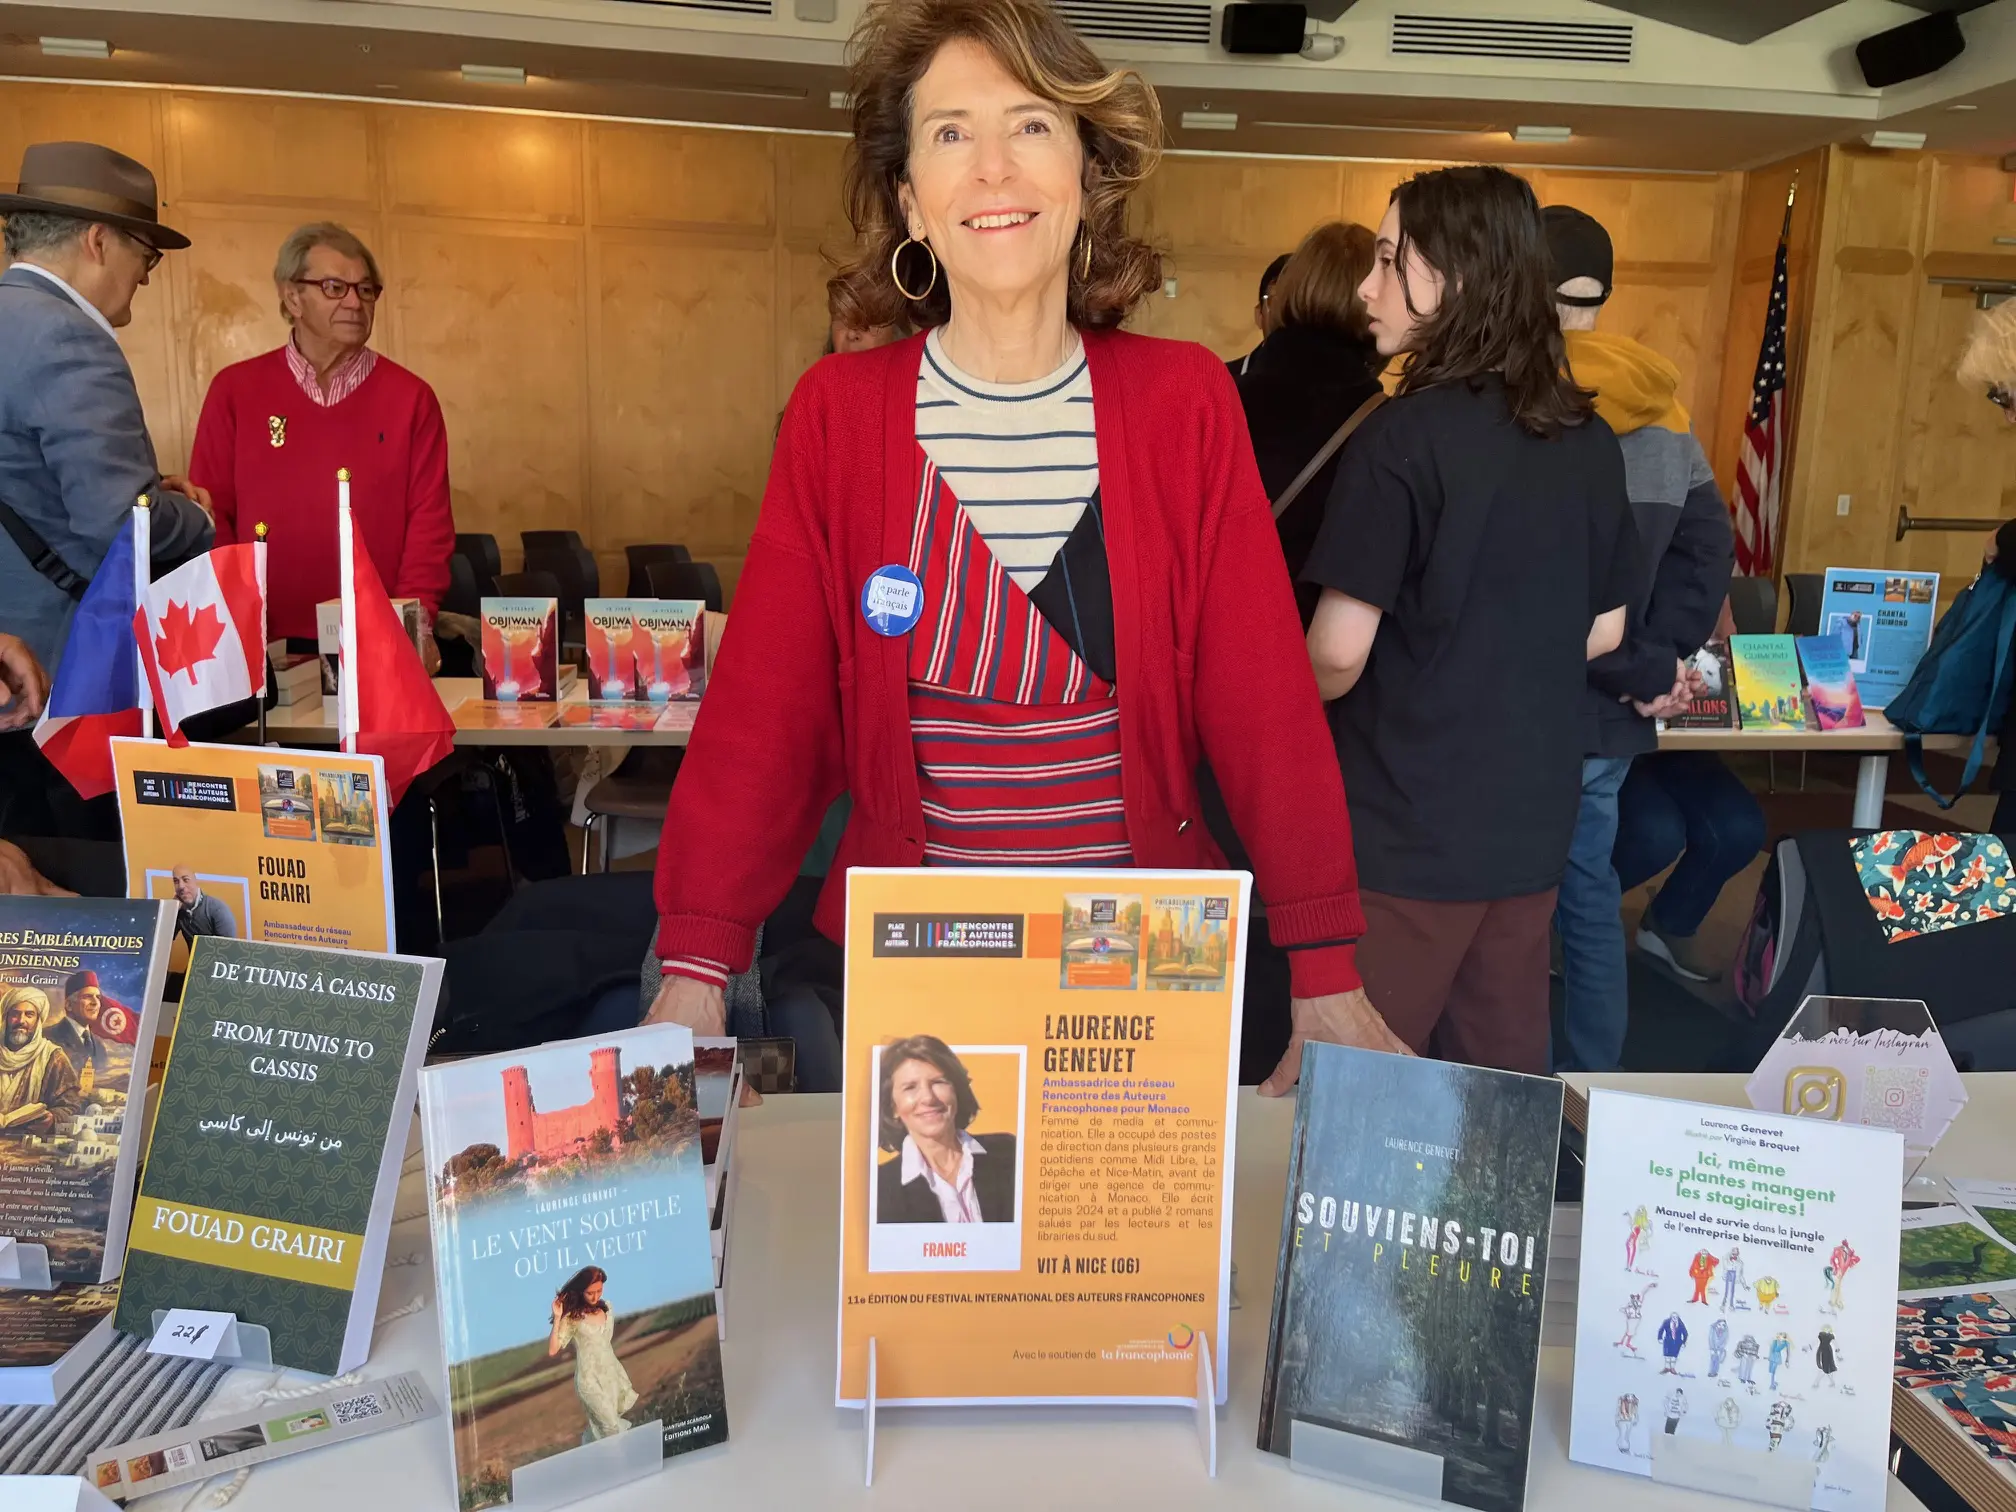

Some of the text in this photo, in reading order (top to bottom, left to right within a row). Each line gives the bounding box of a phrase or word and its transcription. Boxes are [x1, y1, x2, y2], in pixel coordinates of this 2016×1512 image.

[886, 585, 910, 597] parle
[489, 616, 542, 628] OBJIWANA
[638, 618, 692, 630] OBJIWANA
[258, 856, 306, 878] FOUAD
[260, 880, 311, 904] GRAIRI
[264, 920, 314, 932] Ambassadeur
[326, 926, 352, 936] réseau
[956, 922, 1014, 930] RENCONTRE
[22, 930, 144, 949] EMBLÉMATIQUES
[264, 930, 348, 944] Rencontre des Auteurs
[0, 973, 58, 985] Fouad Grairi
[212, 962, 396, 1002] DE TUNIS À CASSIS
[1044, 1014, 1156, 1041] LAURENCE
[212, 1020, 374, 1059] FROM TUNIS TO
[1852, 1036, 1872, 1046] sur
[1874, 1029, 1932, 1056] Instagram
[250, 1056, 318, 1082] CASSIS
[1044, 1047, 1136, 1073] GENEVET
[1043, 1078, 1175, 1088] Ambassadrice du réseau
[1042, 1091, 1166, 1101] Rencontre des Auteurs
[1042, 1103, 1190, 1116] Francophones pour Monaco
[1041, 1116, 1219, 1127] Femme de media et commu-
[1700, 1118, 1784, 1137] Laurence Genevet
[200, 1114, 342, 1150] من تونس إلى كاسي
[1040, 1128, 1084, 1138] nication.
[1088, 1128, 1106, 1138] Elle
[1118, 1129, 1156, 1142] occupé
[1159, 1129, 1178, 1140] des
[1181, 1130, 1216, 1142] postes
[1040, 1142, 1216, 1154] de direction dans plusieurs grands
[1384, 1136, 1460, 1161] LAURENCE GENEVET
[1724, 1134, 1756, 1146] Virginie
[1760, 1139, 1800, 1152] Broquet
[1040, 1154, 1216, 1166] quotidiens comme Midi Libre, La
[1698, 1151, 1786, 1176] Ici, même
[1040, 1166, 1216, 1178] Dépêche et Nice-Matin, avant de
[1650, 1160, 1836, 1202] les plantes mangent
[1040, 1180, 1215, 1193] diriger une agence de commu-
[1676, 1181, 1700, 1200] les
[535, 1187, 618, 1214] LAURENCE GENEVET
[1038, 1205, 1214, 1218] depuis 2024 et a publié 2 romans
[472, 1194, 682, 1260] LE VENT SOUFFLE
[1038, 1218, 1213, 1230] salués par les lecteurs et les
[1298, 1191, 1536, 1270] SOUVIENS-TOI
[1655, 1206, 1825, 1242] Manuel de survie dans la jungle
[152, 1206, 346, 1264] FOUAD GRAIRI
[1038, 1231, 1118, 1241] librairies du sud.
[1664, 1220, 1814, 1254] de l'entreprise bienveillante
[514, 1230, 648, 1278] OÙ IL VEUT
[923, 1242, 967, 1258] FRANCE
[1038, 1254, 1140, 1274] VIT À NICE (06)
[1295, 1227, 1532, 1296] ET PLEURE
[848, 1292, 1205, 1304] 11e ÉDITION DU FESTIVAL INTERNATIONAL DES AUTEURS FRANCOPHONES
[1012, 1350, 1096, 1360] Avec le soutien de
[1101, 1350, 1114, 1360] la
[664, 1428, 692, 1441] ÉDITIONS
